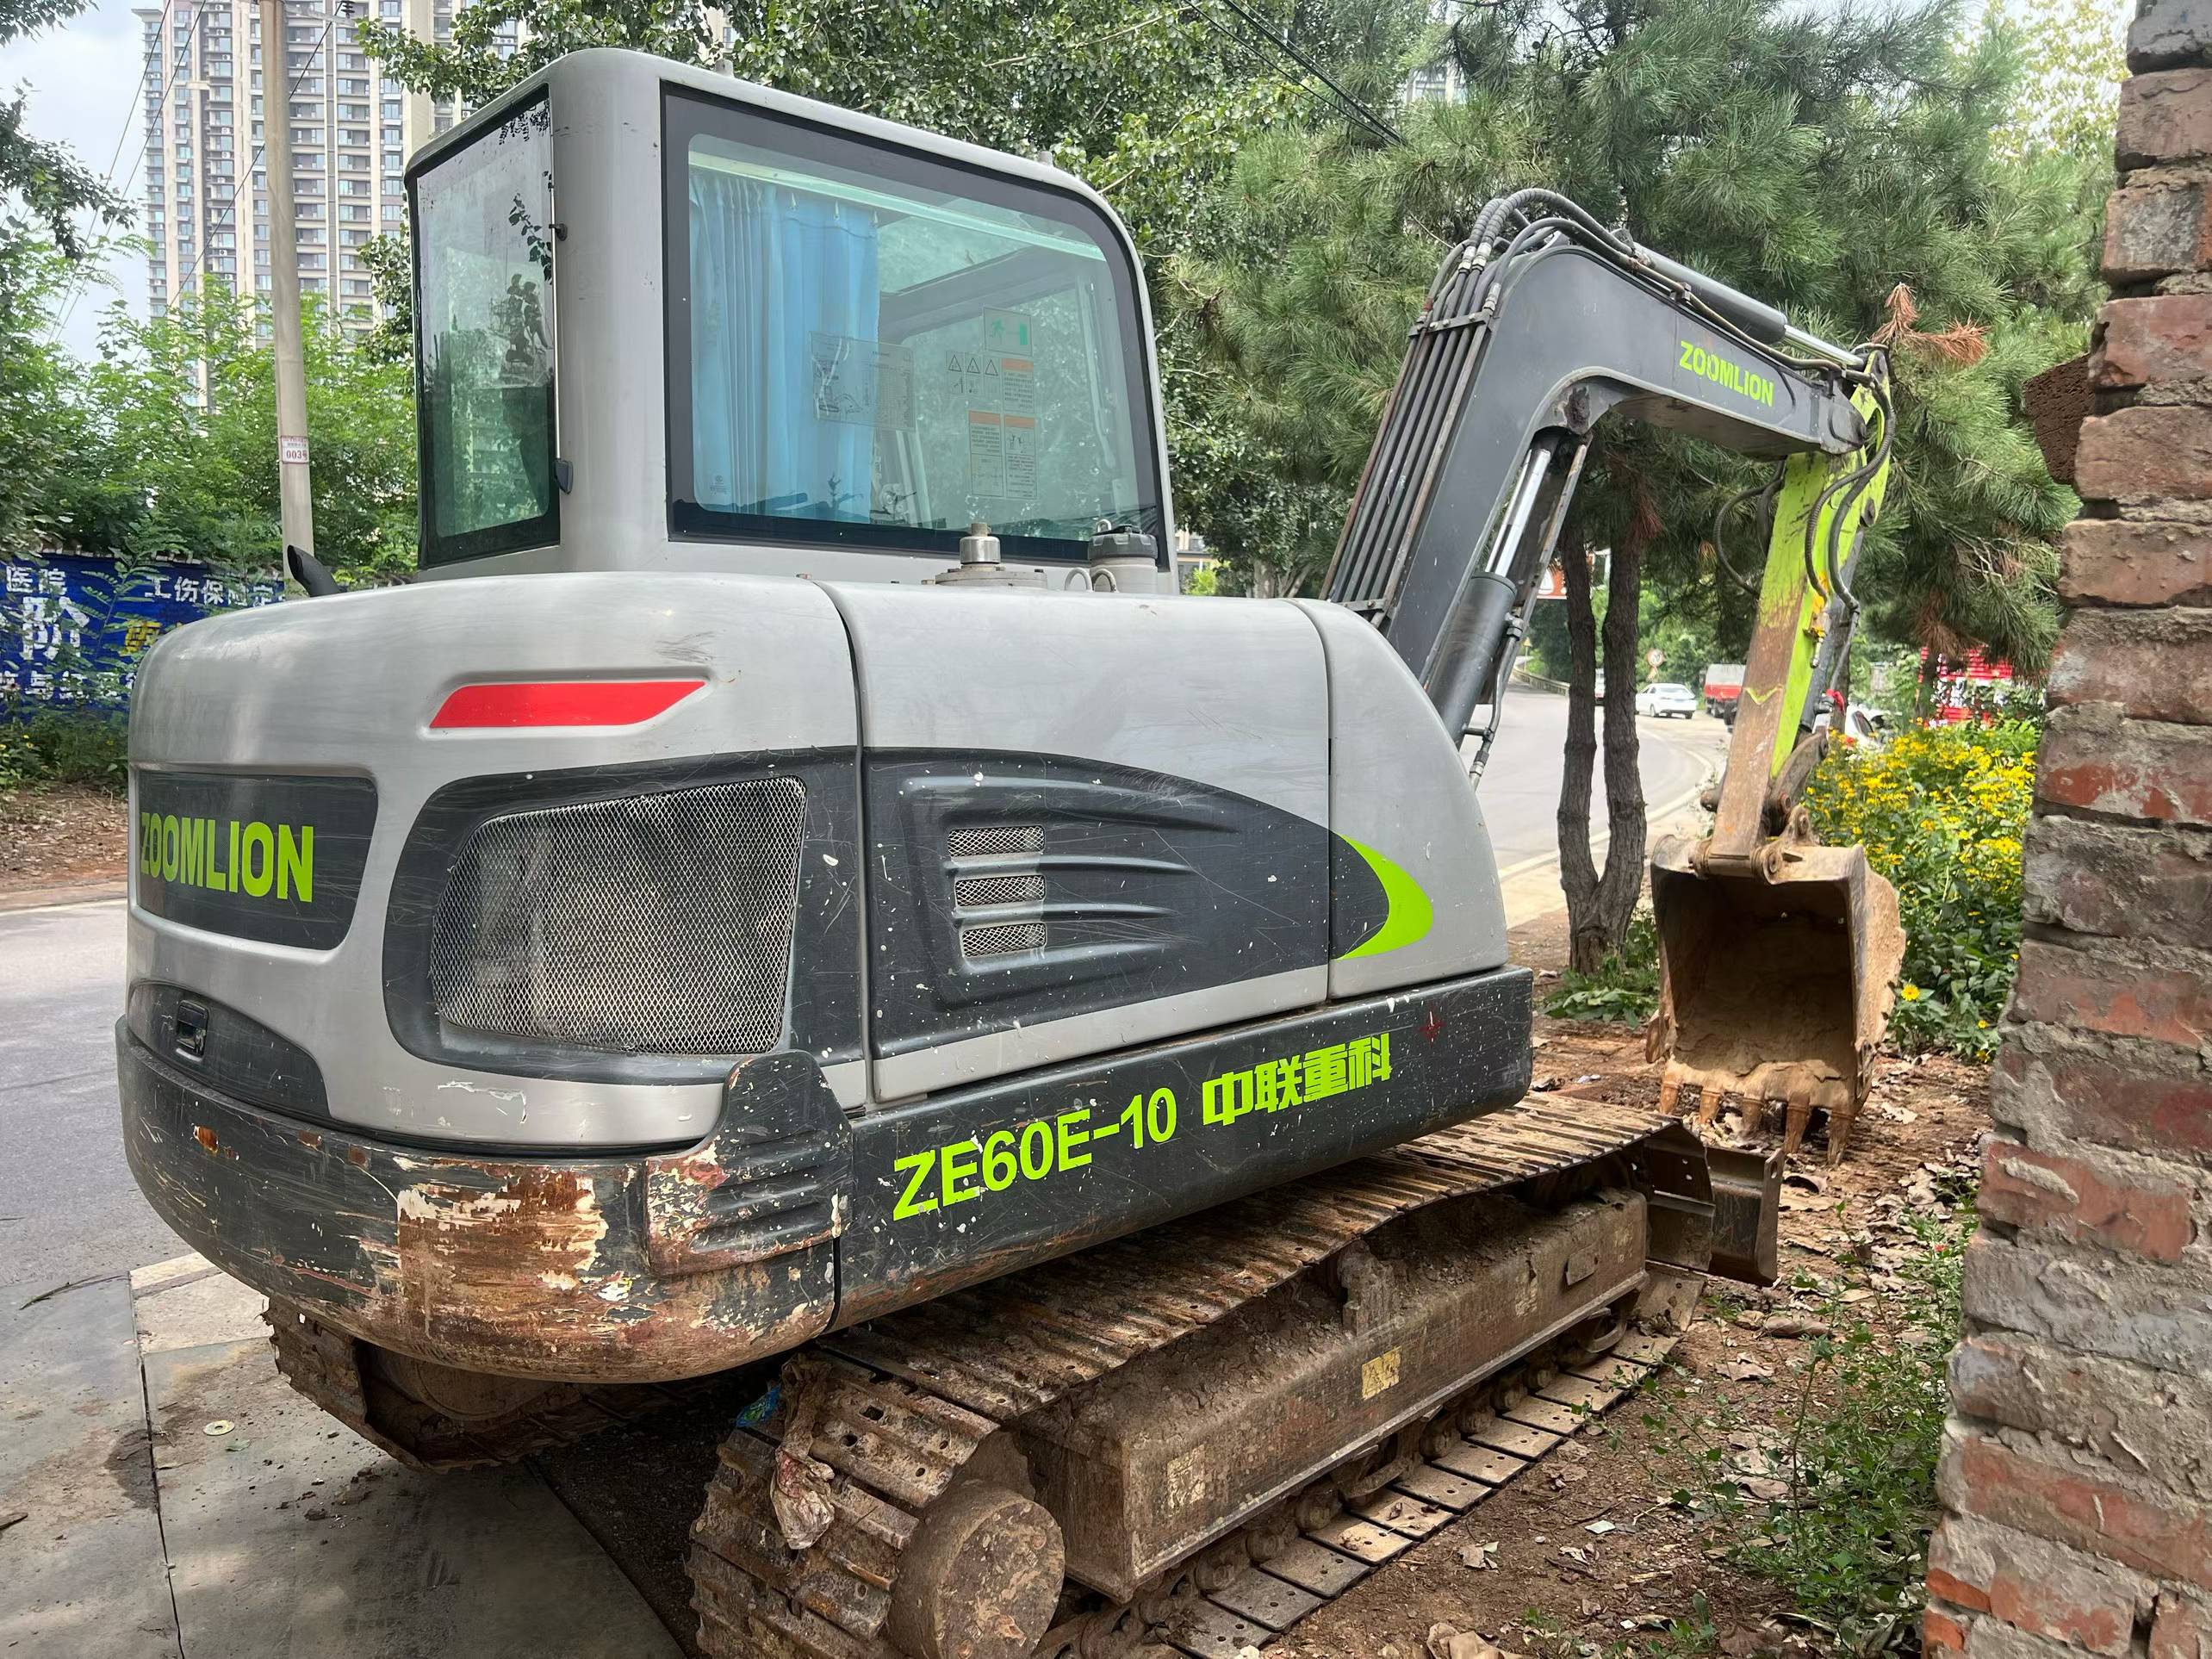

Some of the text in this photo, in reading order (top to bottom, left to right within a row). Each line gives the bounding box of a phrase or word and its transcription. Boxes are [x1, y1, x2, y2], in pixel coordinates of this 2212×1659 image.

[1679, 341, 1775, 407] ZOOMLION
[6, 565, 67, 595] 医院
[140, 812, 314, 903] ZOOMLION
[892, 1032, 1392, 1221] ZE60E-10 中联重科
